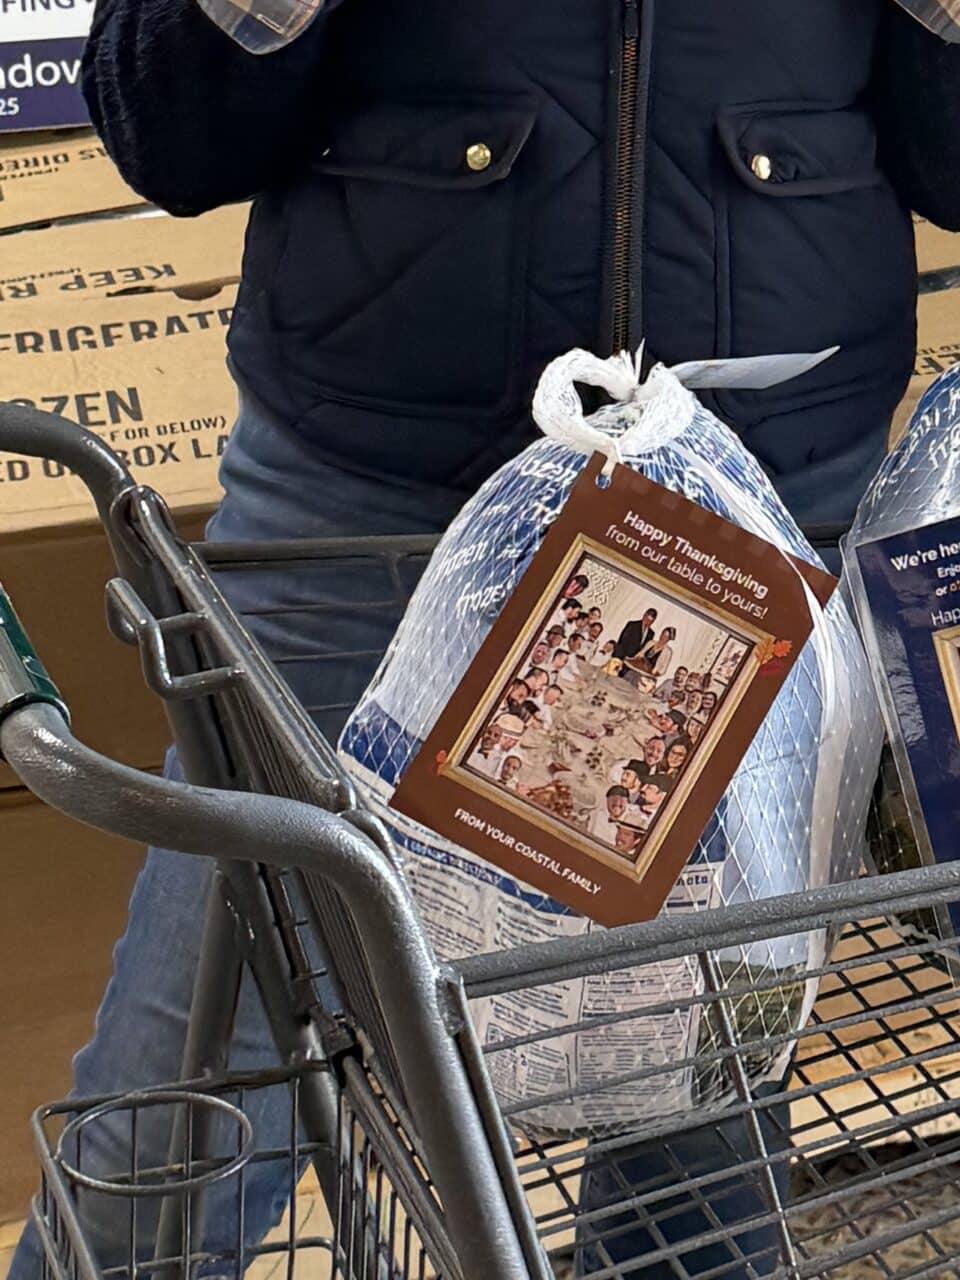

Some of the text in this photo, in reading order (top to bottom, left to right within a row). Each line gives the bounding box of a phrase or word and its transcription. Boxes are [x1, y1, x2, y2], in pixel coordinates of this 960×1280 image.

[0, 53, 82, 89] do
[0, 153, 69, 172] DIRE
[58, 263, 177, 291] KEEP
[8, 387, 144, 427] ZEN
[124, 427, 150, 440] OR
[156, 415, 227, 436] BELOW)
[623, 510, 769, 600] Happy Thanksgiving
[890, 546, 938, 571] We're
[605, 524, 769, 620] from our table to yours!
[936, 586, 949, 597] or
[454, 808, 486, 831] FROM
[486, 824, 515, 849] YOUR
[514, 842, 562, 875] COASTAL
[561, 867, 601, 895] FAMILY
